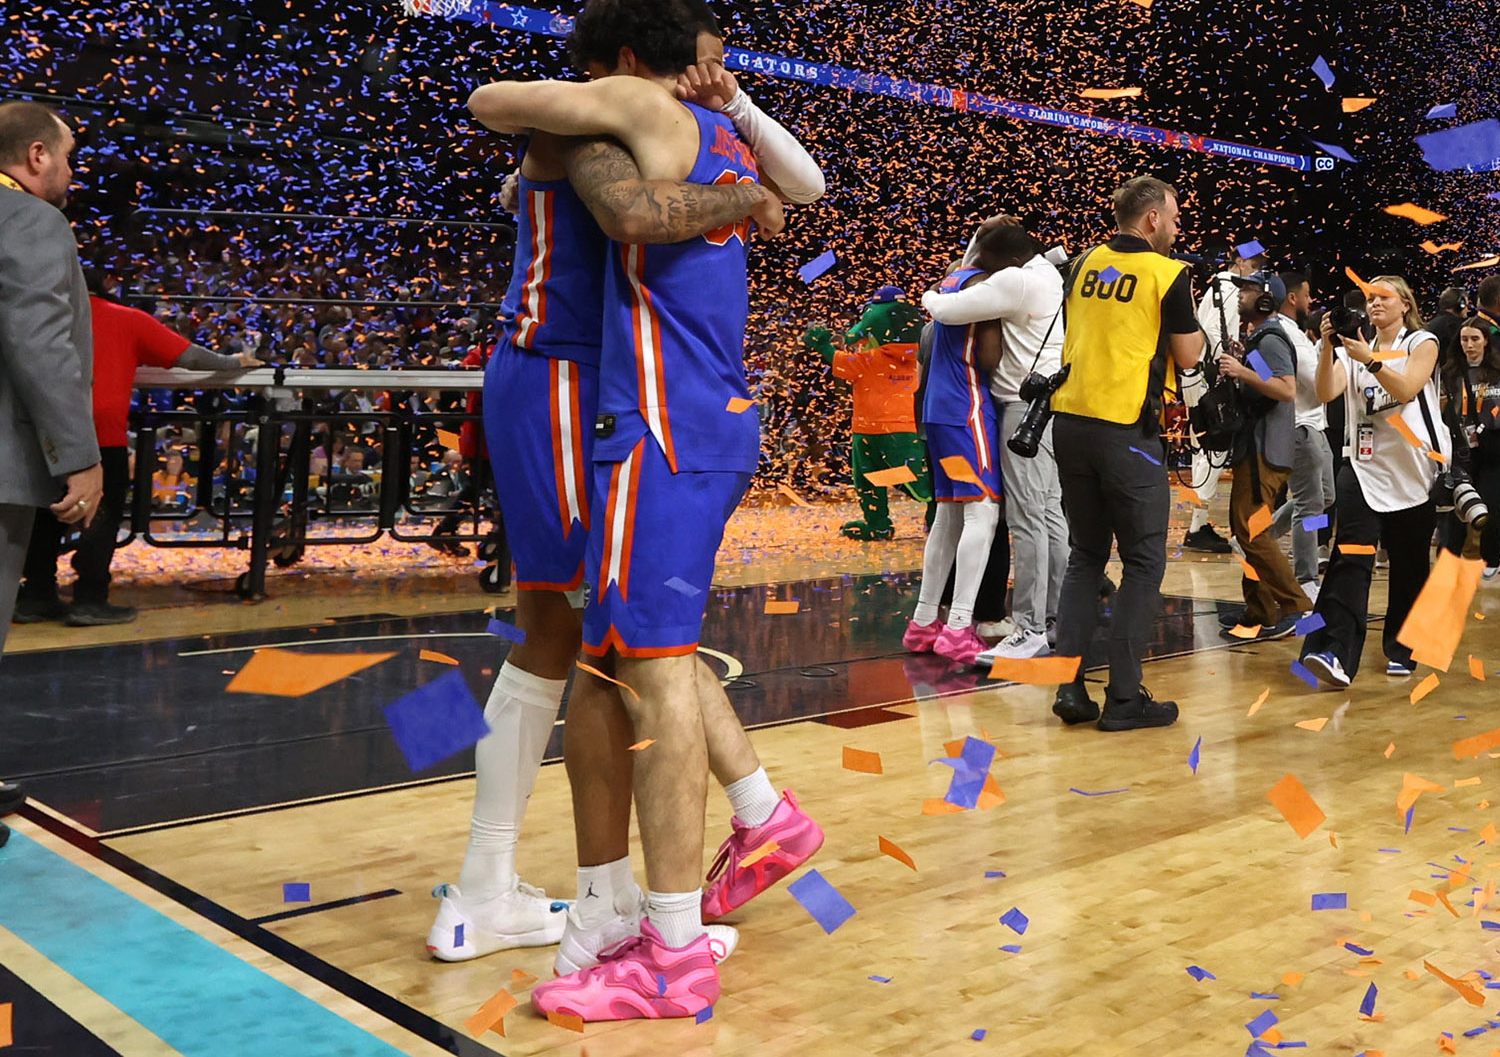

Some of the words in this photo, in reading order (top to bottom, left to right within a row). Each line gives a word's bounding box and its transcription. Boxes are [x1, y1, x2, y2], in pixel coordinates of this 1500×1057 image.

[738, 53, 818, 80] GATORS
[1028, 108, 1070, 124] FLORIDA
[1073, 116, 1110, 132] GATORS
[1212, 143, 1252, 158] NATIONAL
[1253, 151, 1296, 166] CHAMPIONS
